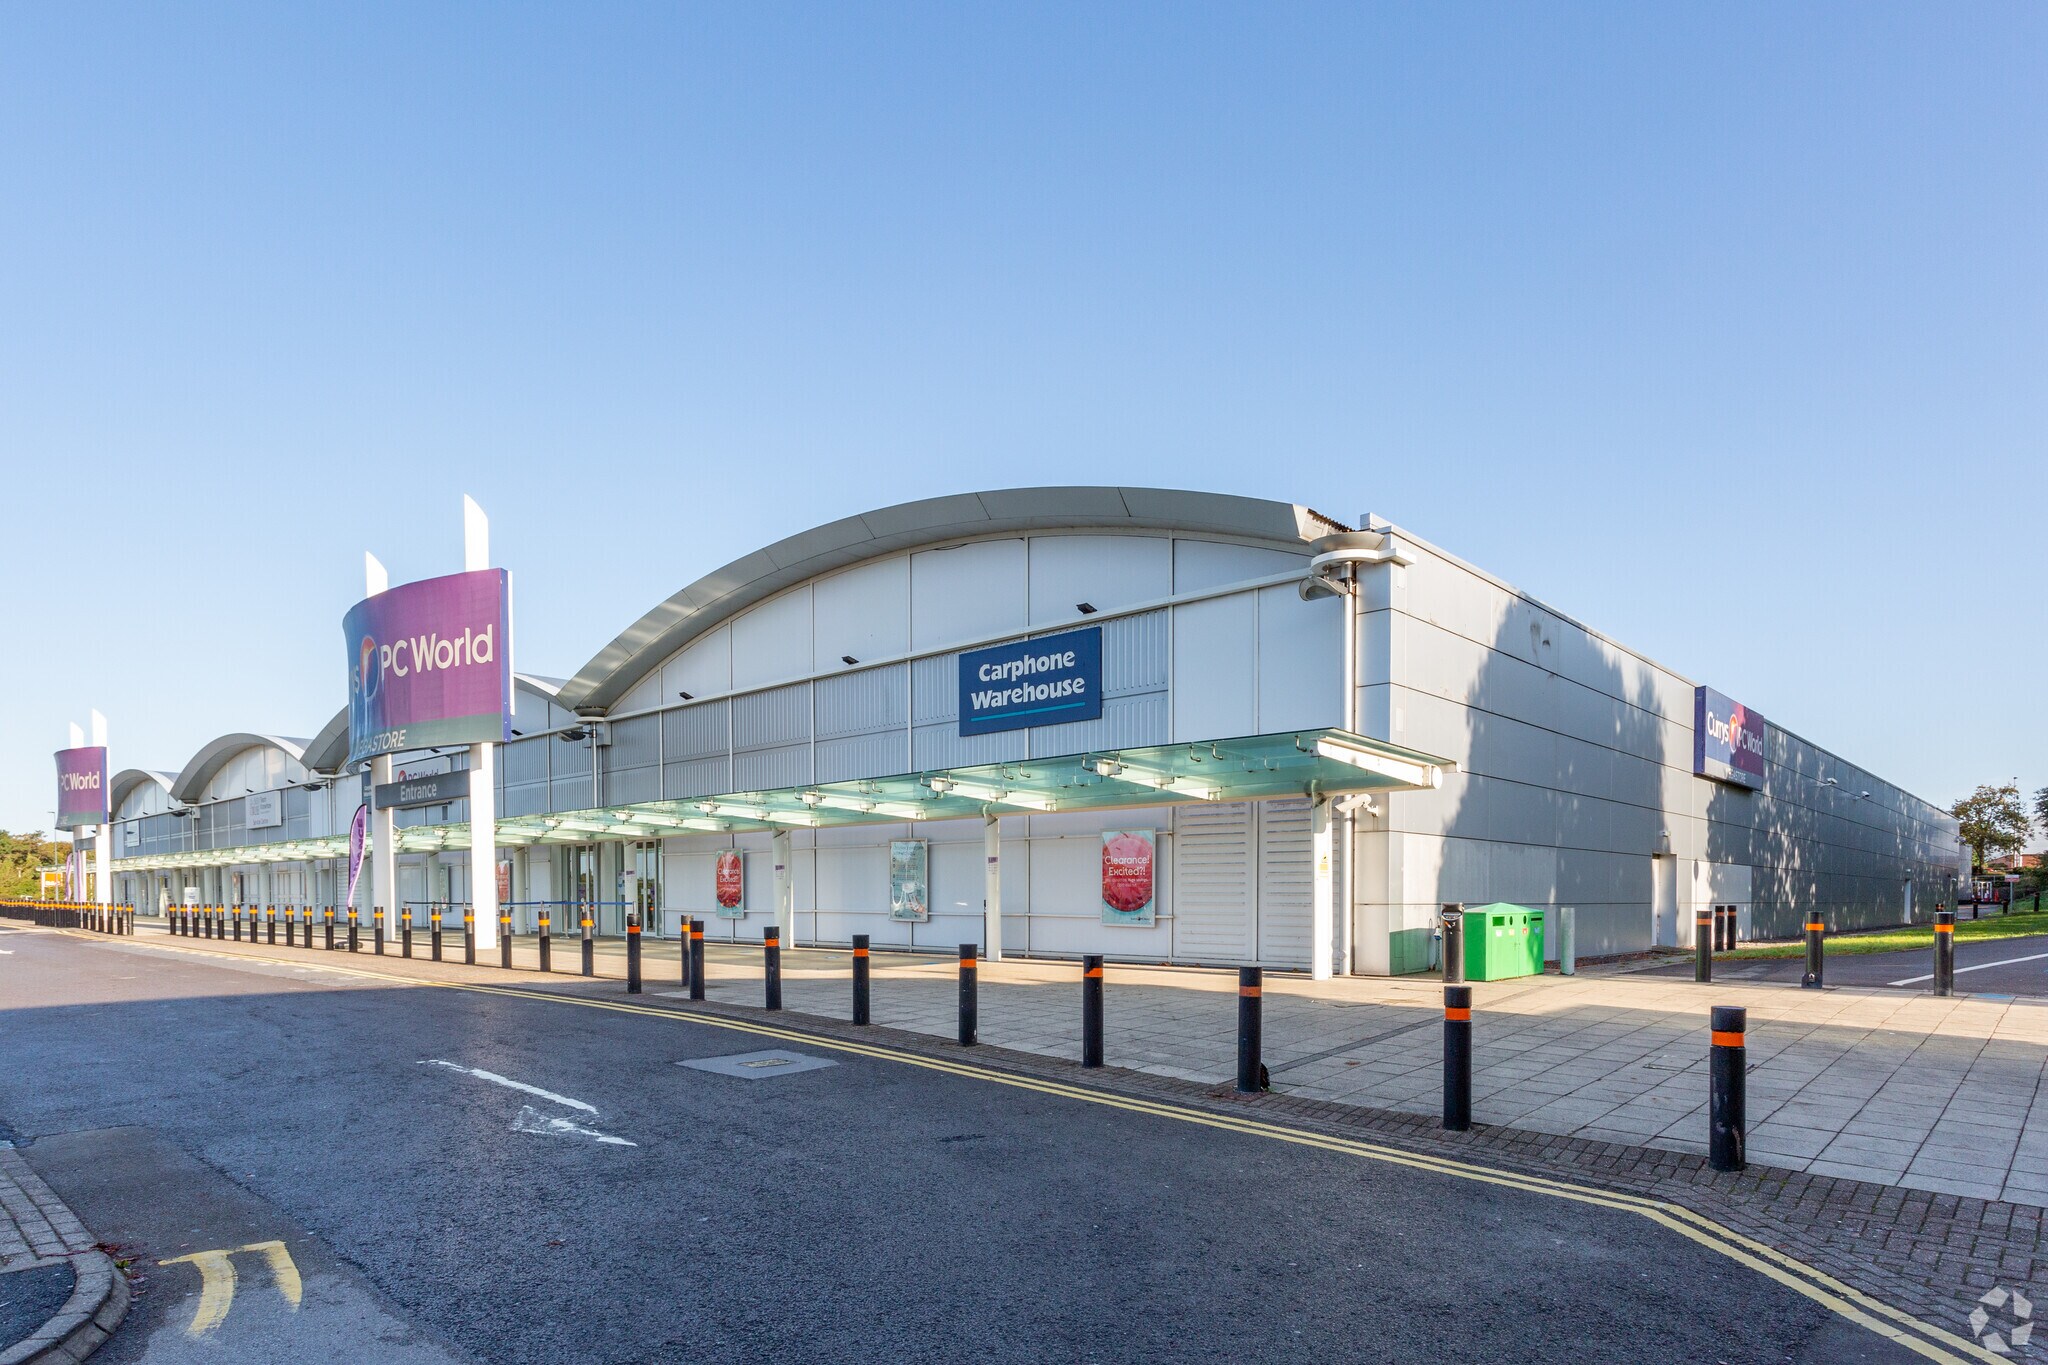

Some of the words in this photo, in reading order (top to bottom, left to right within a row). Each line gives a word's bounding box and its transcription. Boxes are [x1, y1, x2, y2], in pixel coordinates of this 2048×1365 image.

[380, 639, 409, 677] PC
[410, 623, 493, 673] World
[978, 650, 1075, 685] Carphone
[971, 676, 1086, 711] Warehouse
[1707, 711, 1729, 745] Currys
[1736, 726, 1747, 750] PC
[1747, 732, 1763, 756] World
[69, 770, 100, 791] World
[400, 783, 437, 801] Entrance
[1104, 854, 1150, 865] Clearance!
[1108, 866, 1146, 876] Excited?!
